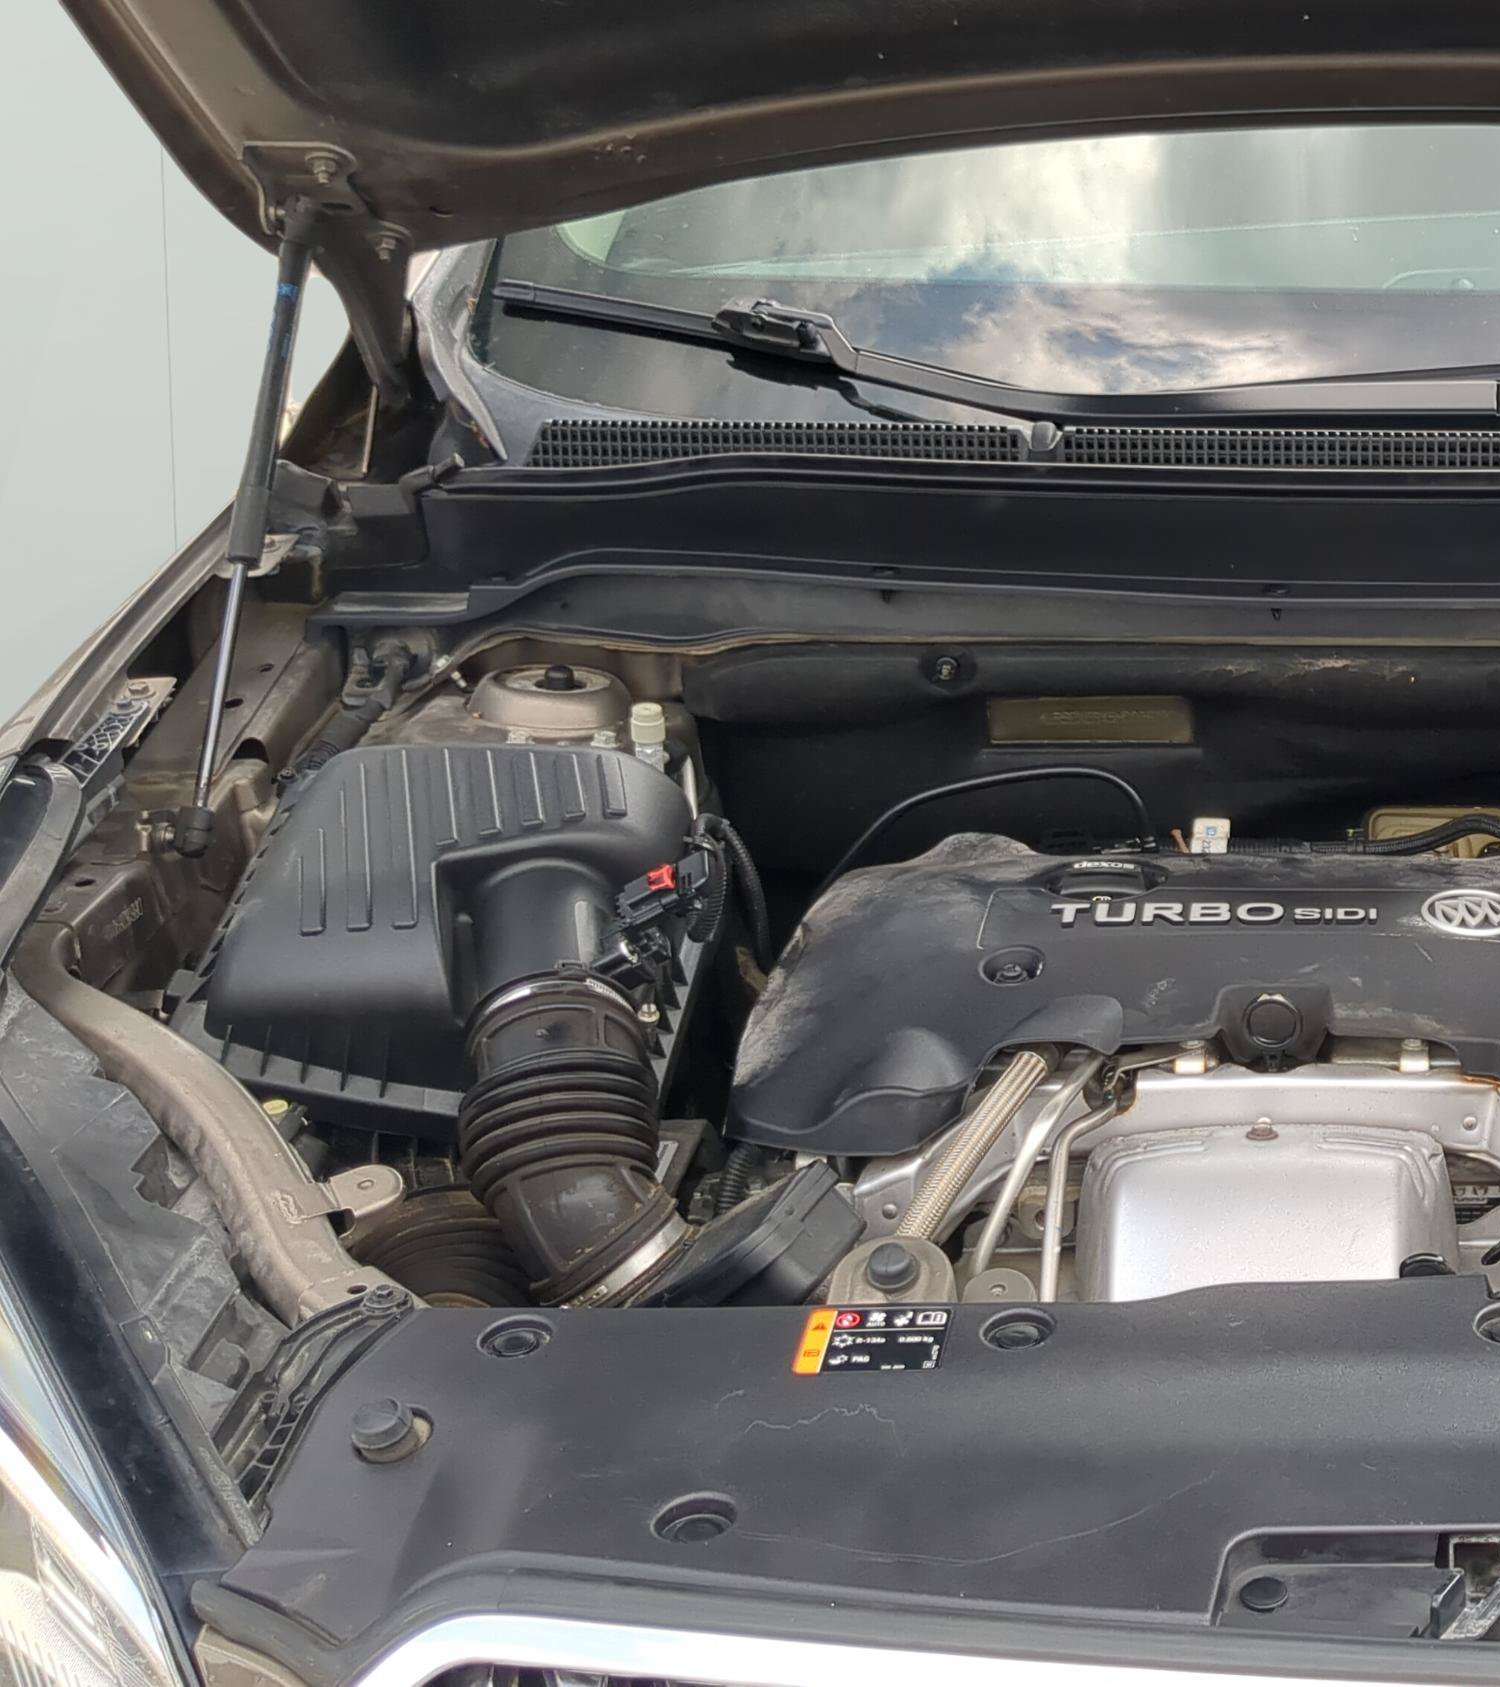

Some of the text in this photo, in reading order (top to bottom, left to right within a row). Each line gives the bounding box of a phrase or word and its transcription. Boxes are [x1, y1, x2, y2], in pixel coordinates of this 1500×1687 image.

[1073, 860, 1135, 870] dexos
[1051, 902, 1378, 925] TURBO SIDI
